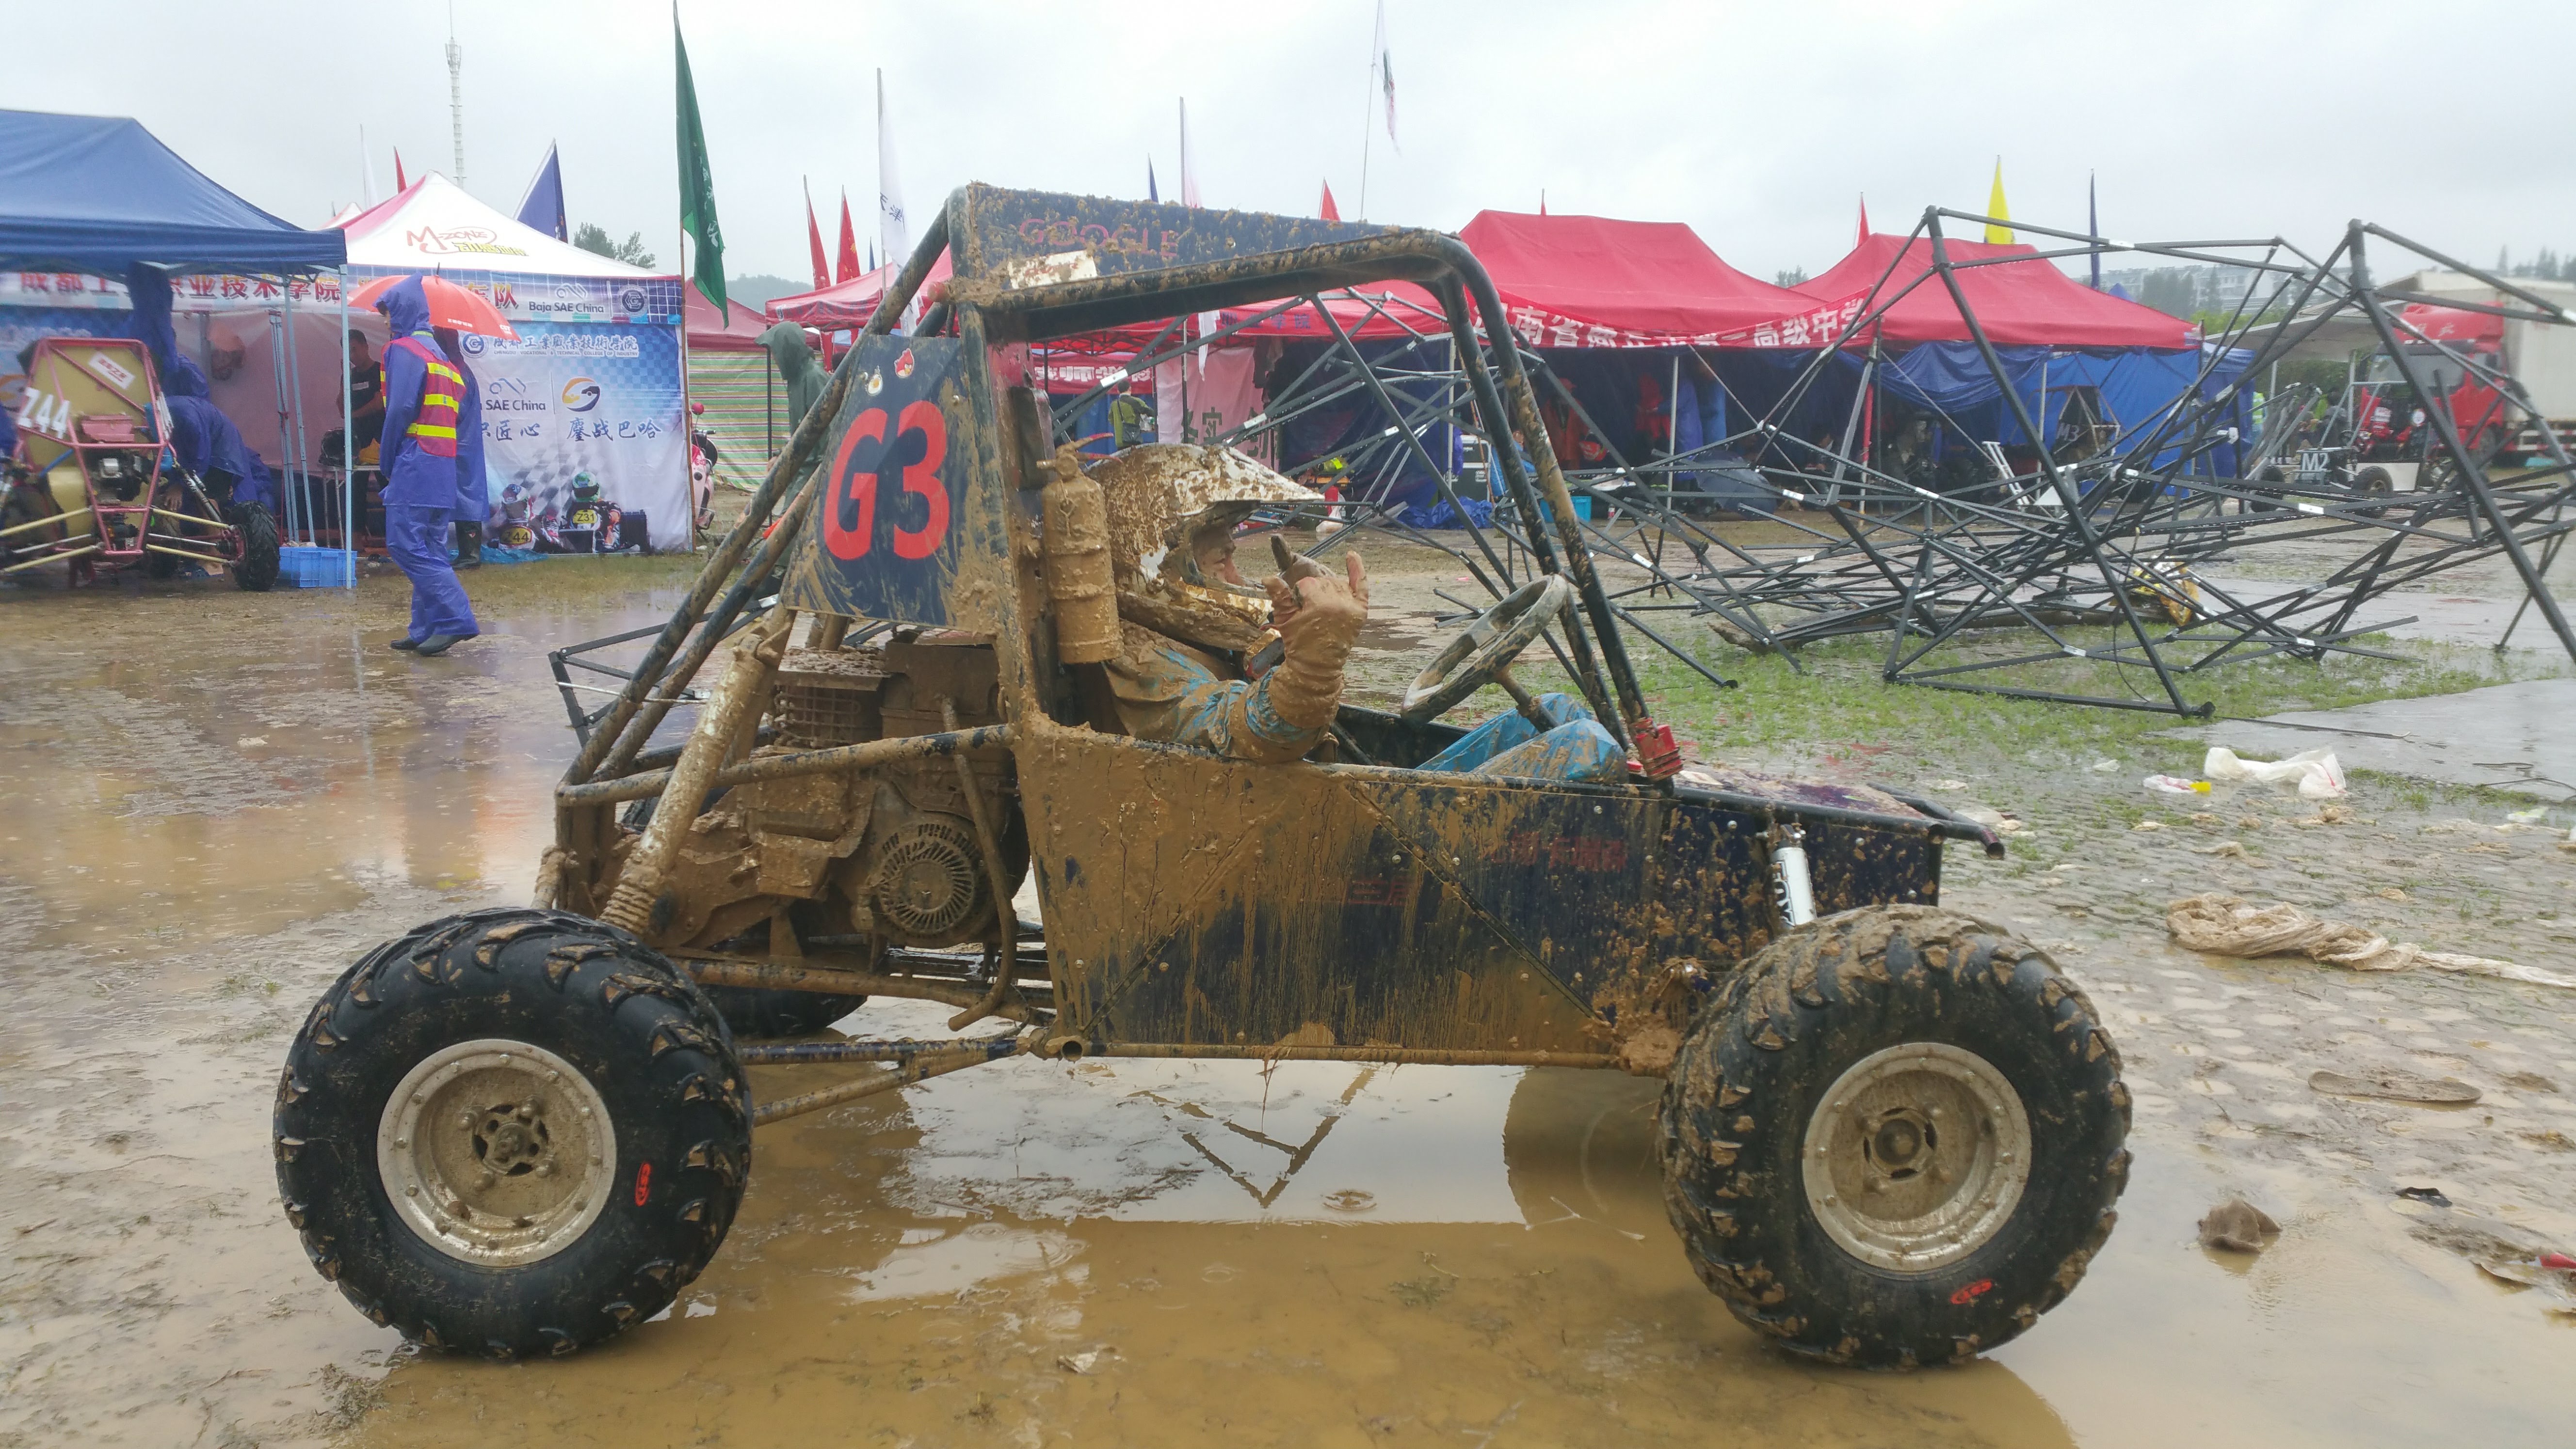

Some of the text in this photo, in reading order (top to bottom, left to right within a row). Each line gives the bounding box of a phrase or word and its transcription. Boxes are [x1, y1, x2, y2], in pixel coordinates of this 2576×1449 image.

[529, 301, 604, 313] Baja SAE China
[486, 399, 546, 411] SAE China
[2056, 422, 2079, 442] M3
[2302, 452, 2330, 471] M2
[825, 401, 950, 560] G3
[577, 513, 595, 522] Z31
